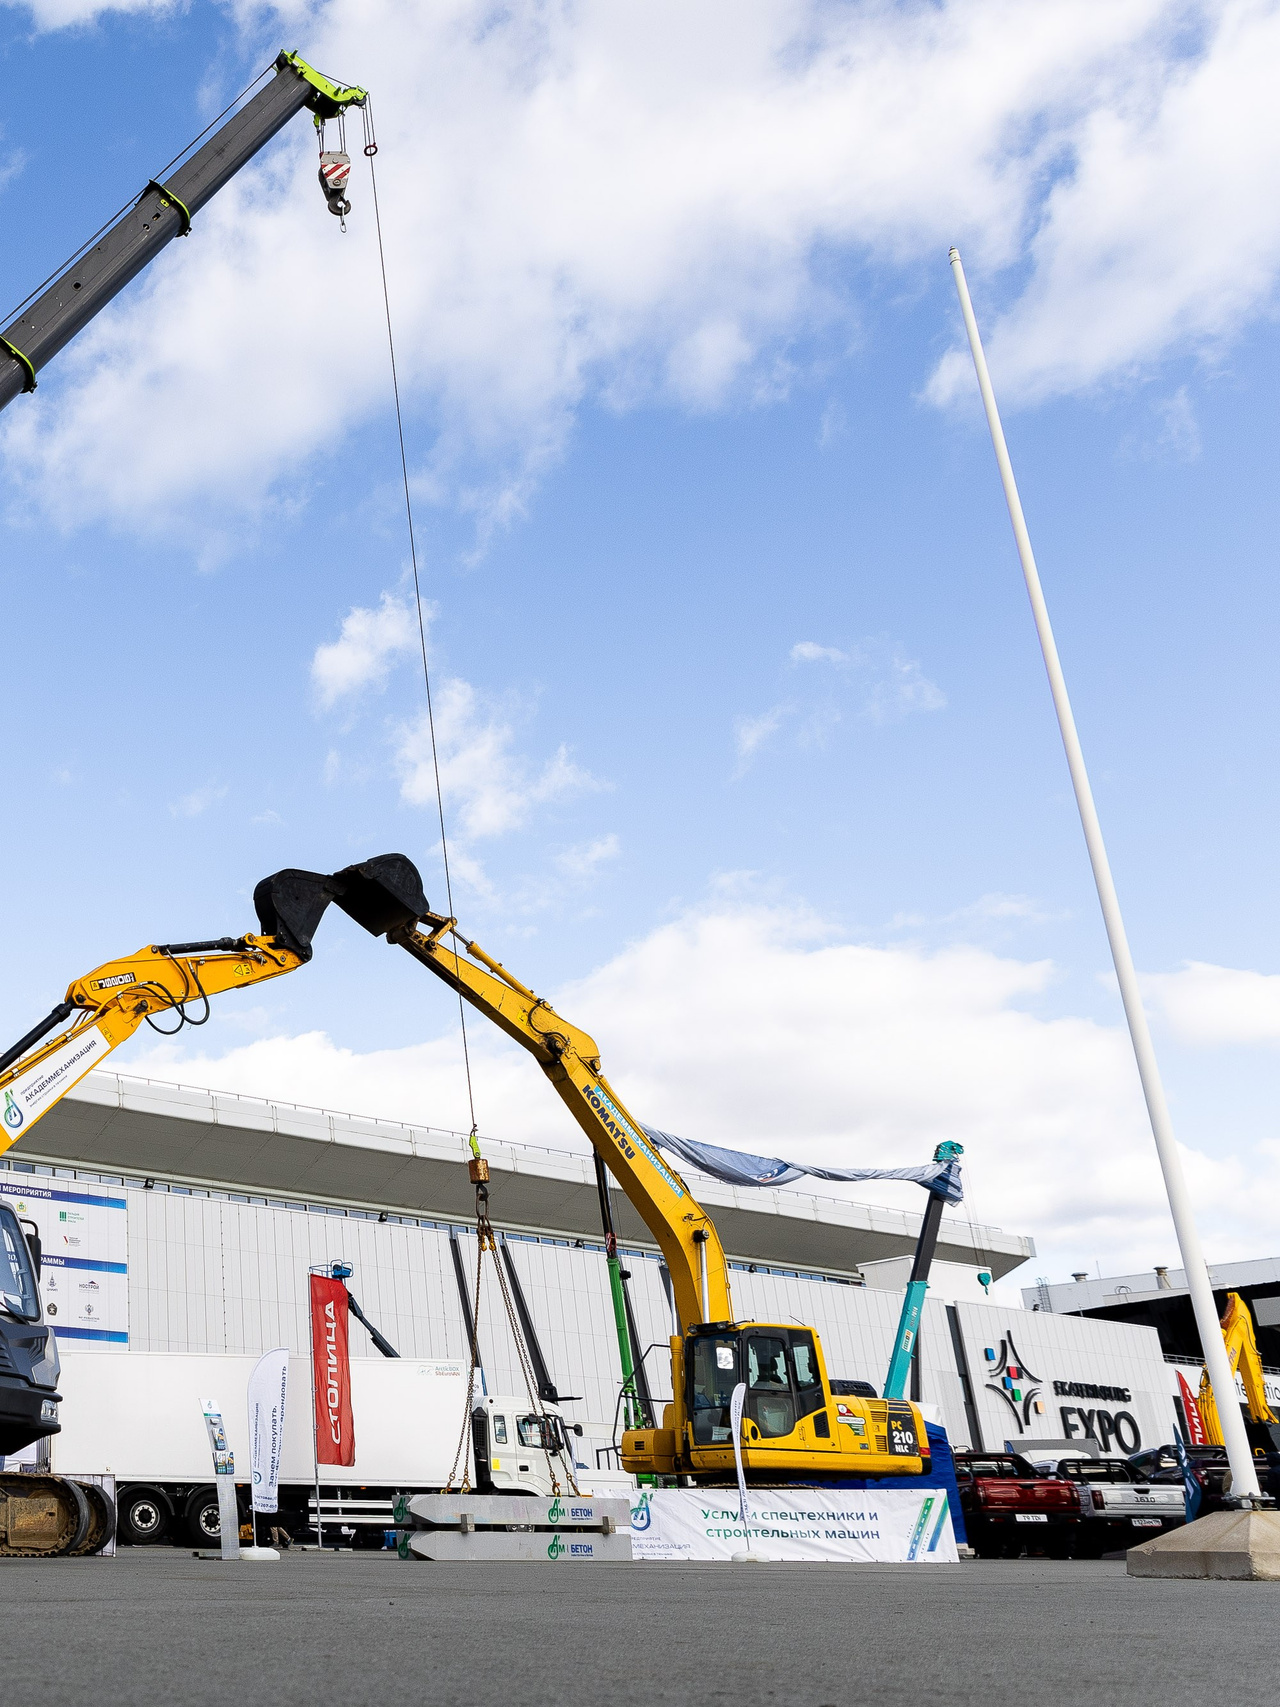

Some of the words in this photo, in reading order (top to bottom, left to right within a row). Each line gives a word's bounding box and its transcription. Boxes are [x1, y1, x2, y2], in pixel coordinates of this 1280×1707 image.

[24, 1039, 97, 1102] АКАДЕММЕХАНИЗАЦИЯ
[582, 1084, 636, 1160] KOMATSU
[597, 1089, 682, 1195] АКАДЕММЕХАНИЗАЦИЯ
[2, 1183, 52, 1198] МЕРОПРИЯТИЯ
[324, 1300, 341, 1445] СТОЛИЦА
[891, 1420, 902, 1430] PC
[1059, 1406, 1141, 1456] EXPO
[892, 1431, 914, 1445] 210
[895, 1444, 909, 1453] NLC
[268, 1456, 276, 1488] Зачем
[571, 1508, 593, 1517] БЕТОН
[701, 1509, 757, 1520] Услуи
[761, 1509, 864, 1522] спецтехники
[868, 1511, 879, 1520] и
[706, 1527, 821, 1540] строительных
[825, 1529, 880, 1539] машин
[571, 1544, 593, 1553] БЕТОН
